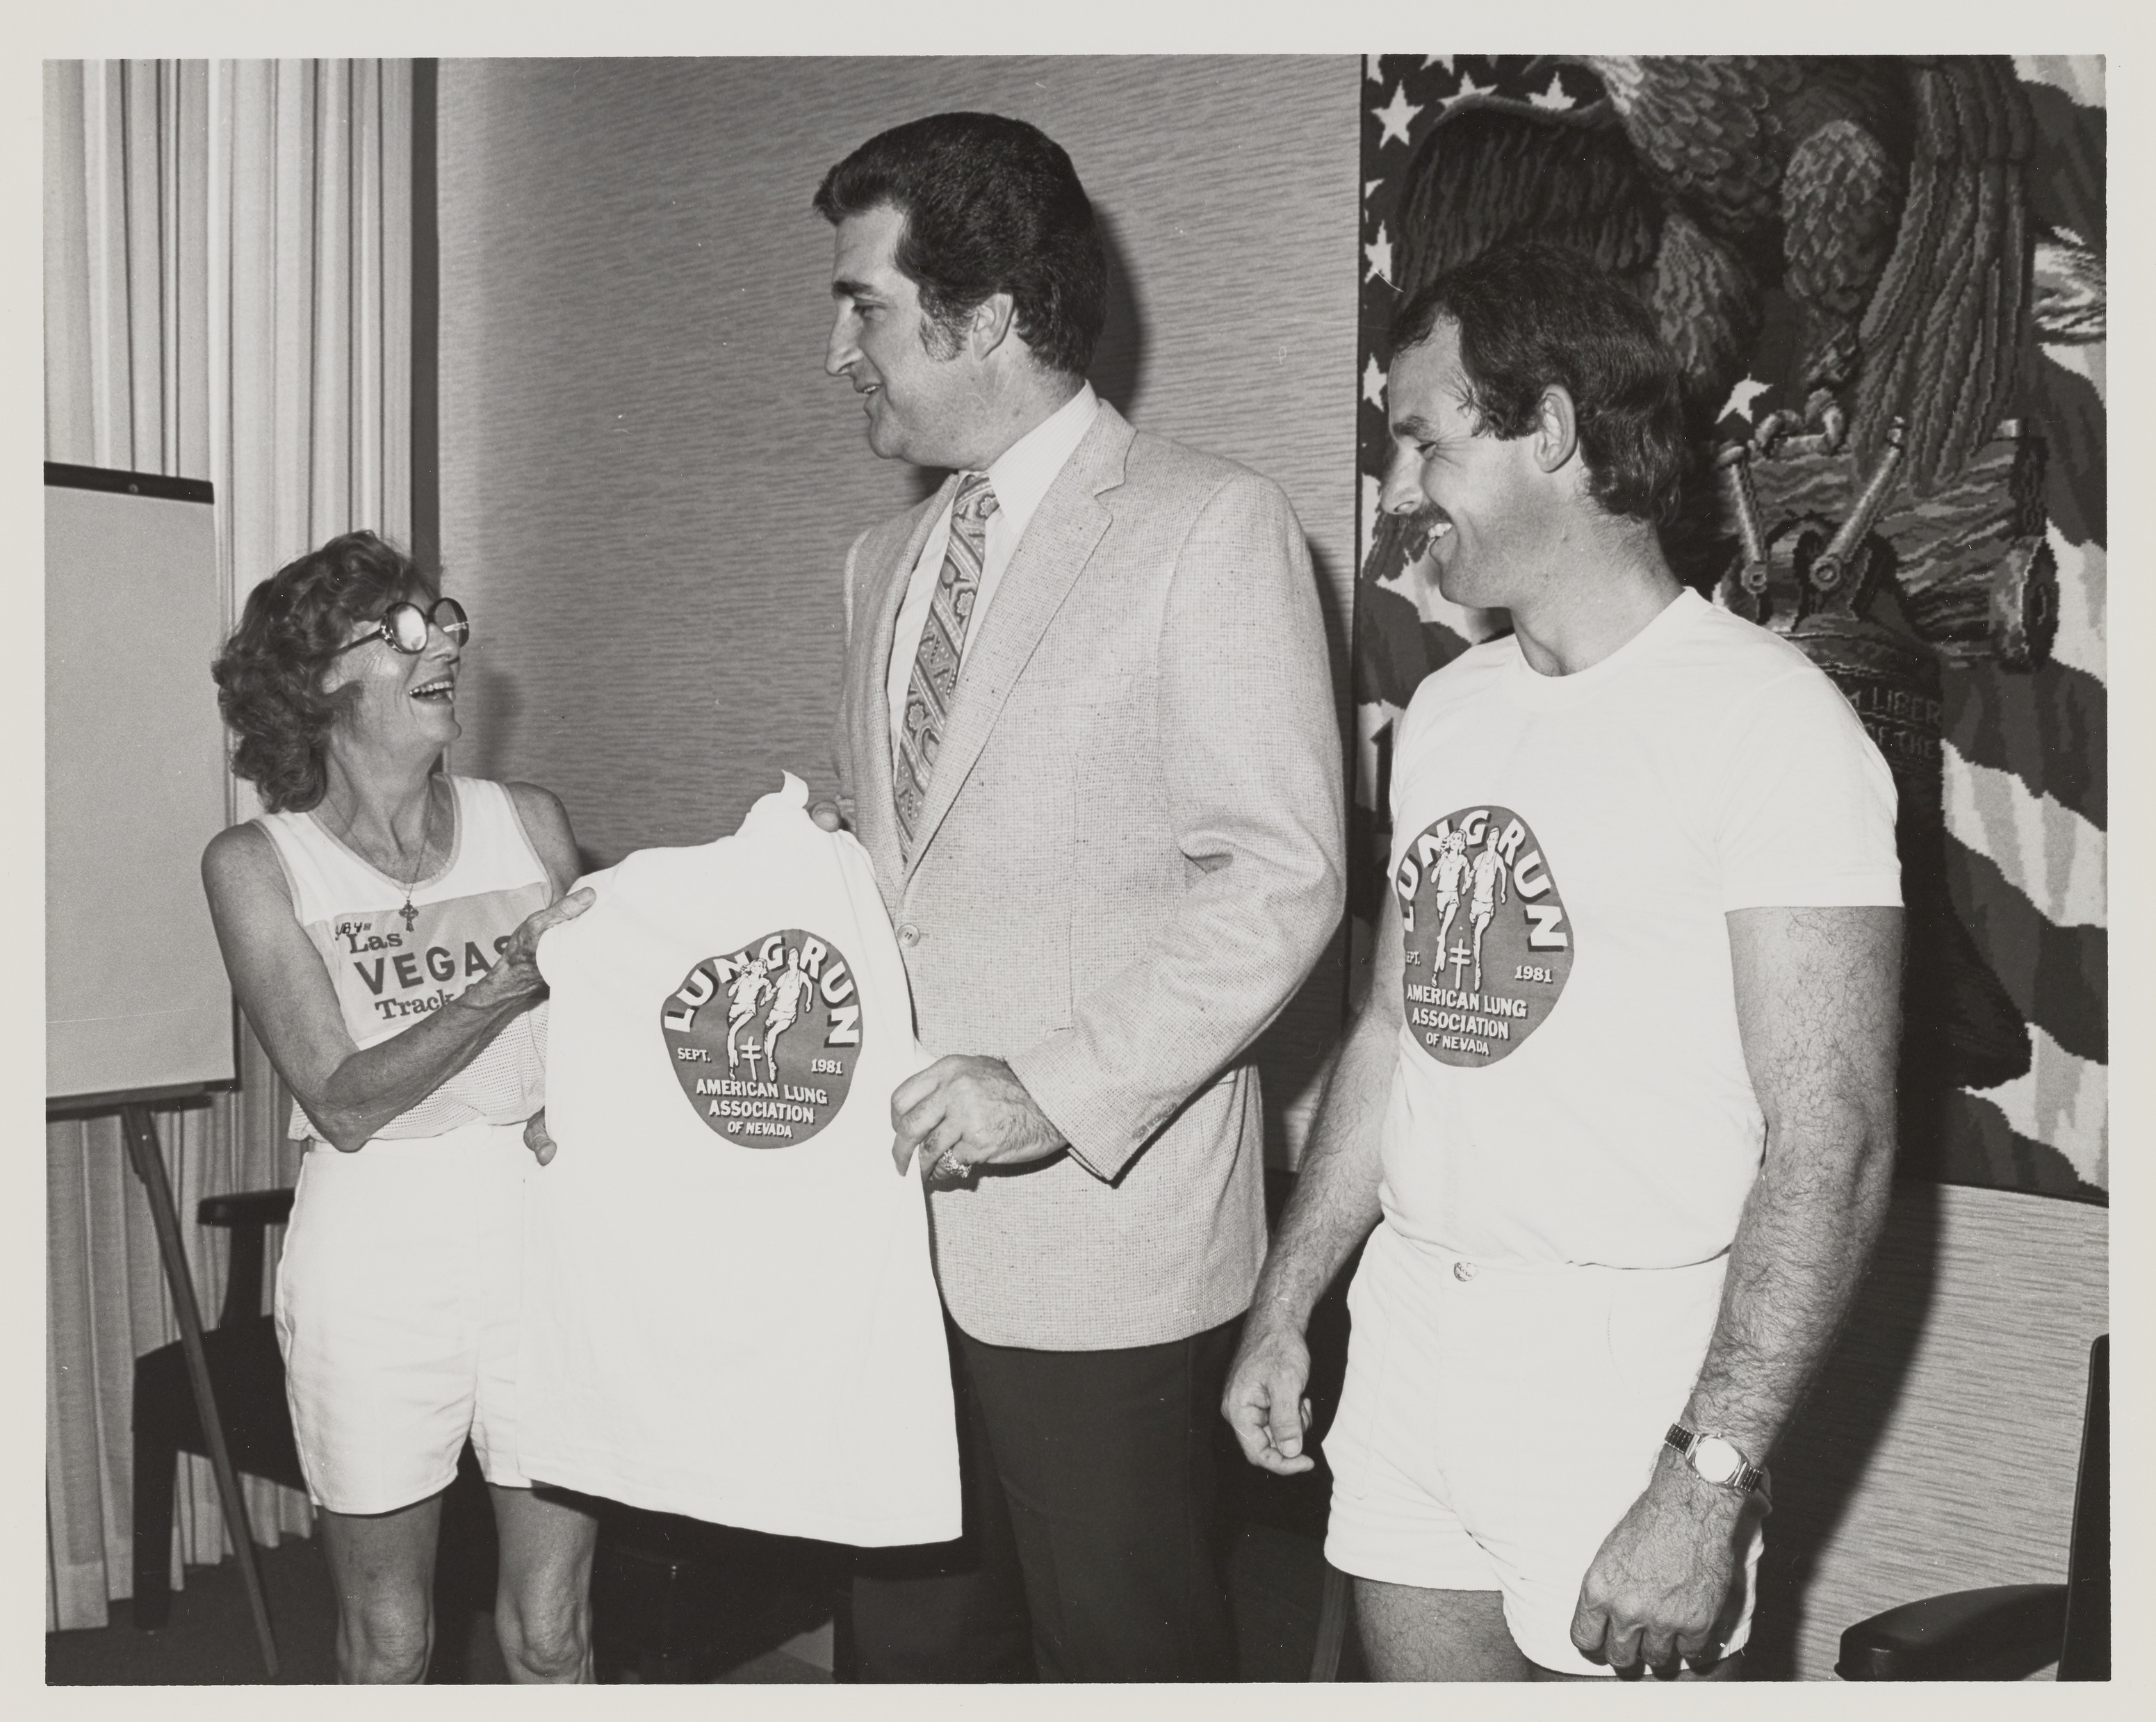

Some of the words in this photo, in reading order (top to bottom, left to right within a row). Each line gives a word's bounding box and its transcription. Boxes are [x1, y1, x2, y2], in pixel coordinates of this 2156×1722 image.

[1497, 818, 1569, 947] RUN
[349, 932, 403, 954] Las
[1405, 950, 1421, 965] EPT.
[1514, 965, 1553, 983] 1981
[664, 936, 783, 1032] LUNG
[800, 936, 860, 1043] RUN
[1407, 983, 1479, 1012] AMERICAN
[1484, 996, 1528, 1017] LUNG
[1412, 1007, 1508, 1039] ASSOCIATION
[1426, 1032, 1439, 1046] OF
[1442, 1035, 1489, 1056] NEVADA
[677, 1047, 711, 1062] SEPT.
[811, 1058, 842, 1075] 1981
[696, 1078, 779, 1098] AMERICAN
[784, 1085, 828, 1105] LUNG
[709, 1100, 815, 1123] ASSOCIATION
[727, 1121, 744, 1134] OF
[746, 1122, 793, 1139] NEVADA
